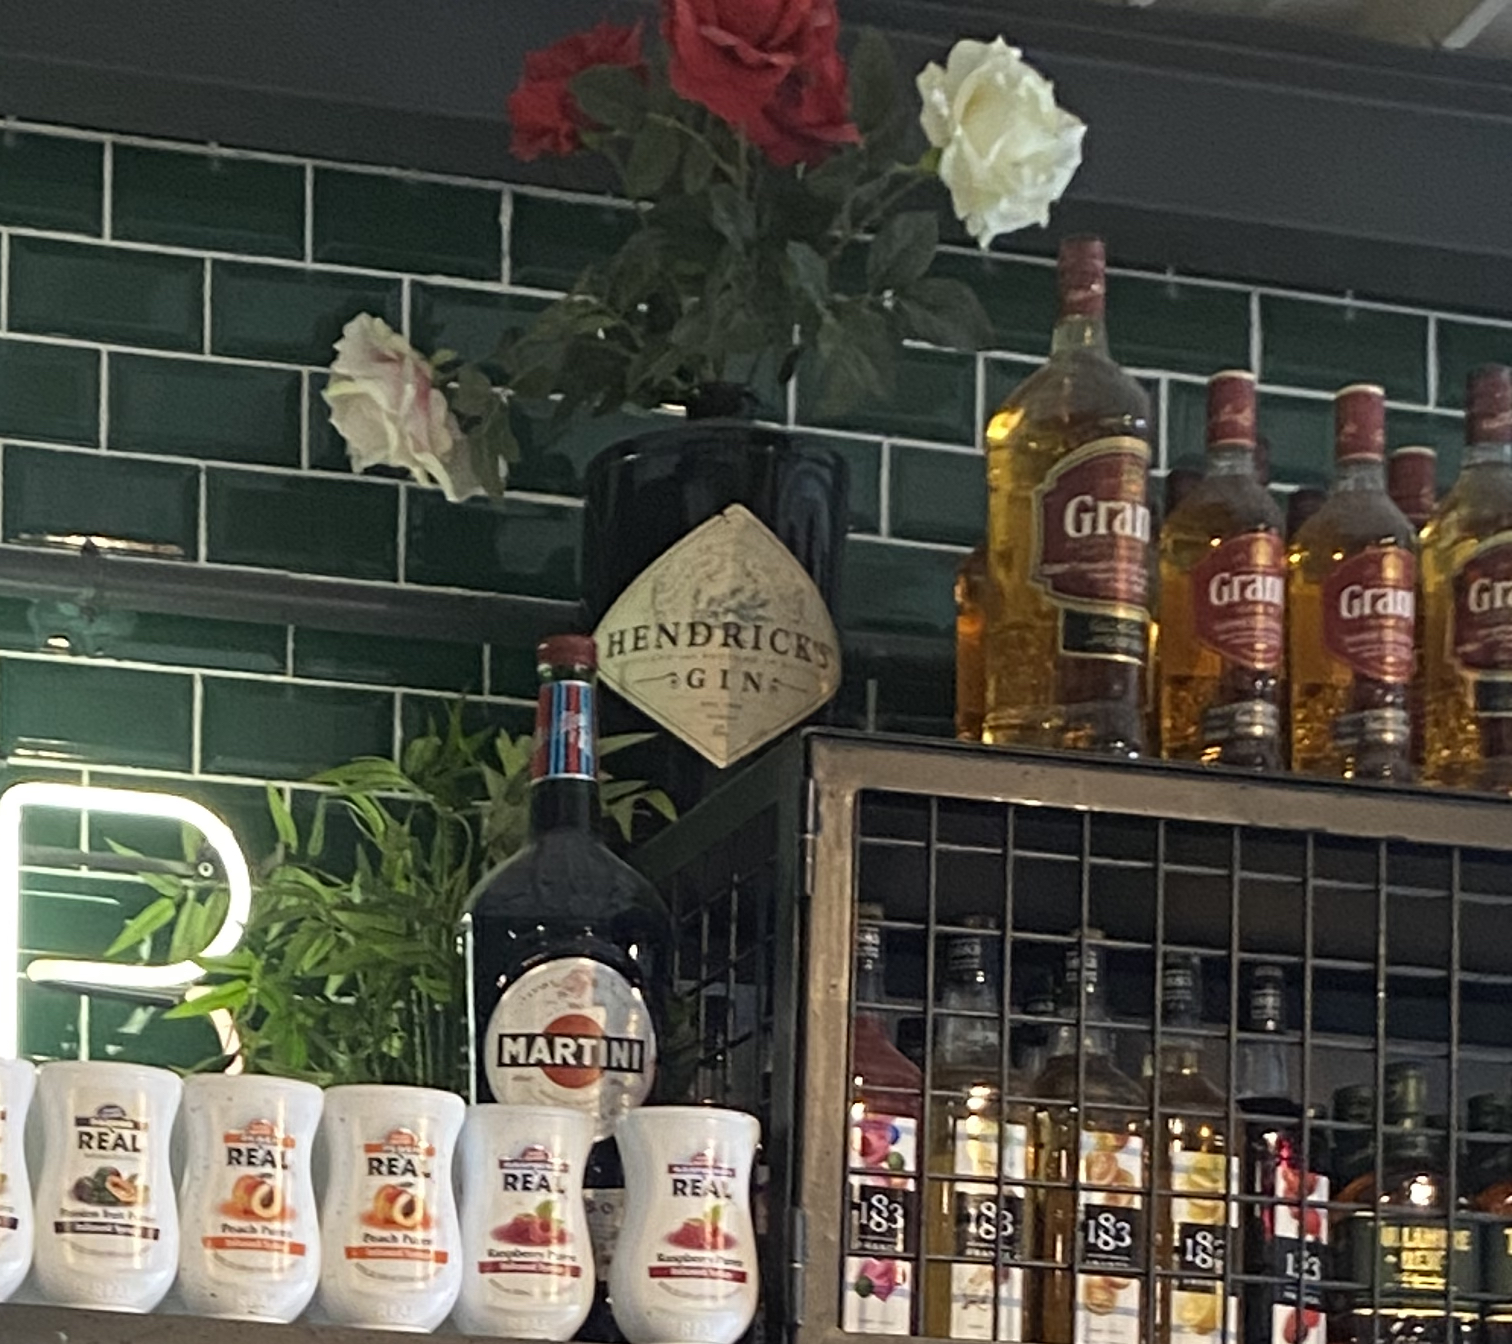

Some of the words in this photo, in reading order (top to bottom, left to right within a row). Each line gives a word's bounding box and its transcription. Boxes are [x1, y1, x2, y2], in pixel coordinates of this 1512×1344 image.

[1064, 495, 1152, 543] Gran
[1209, 571, 1285, 606] Gran
[1340, 584, 1415, 620] Gran
[606, 620, 834, 669] HENDRICK'S
[687, 667, 763, 693] GIN
[501, 1034, 640, 1073] MARTINI
